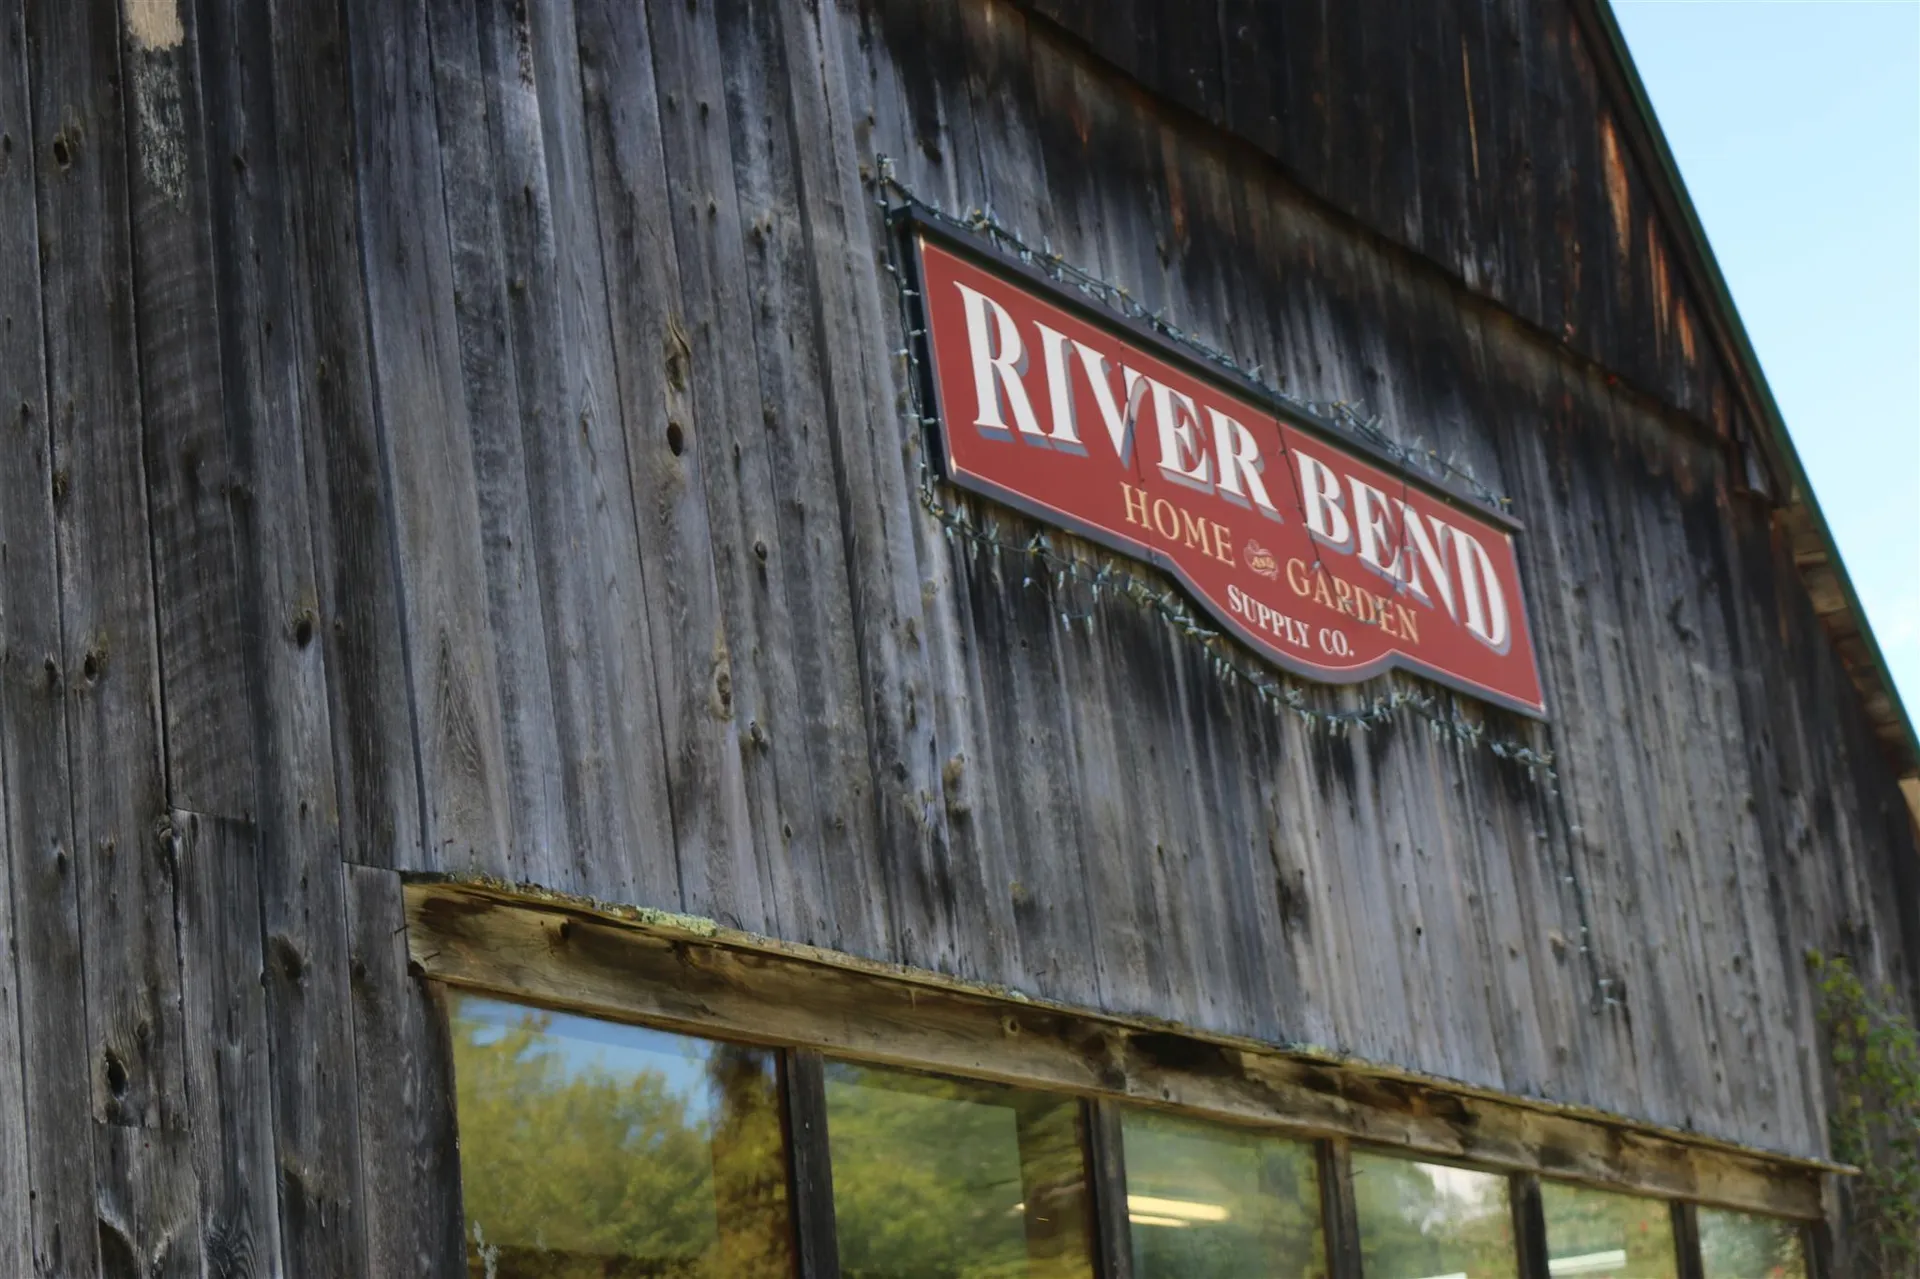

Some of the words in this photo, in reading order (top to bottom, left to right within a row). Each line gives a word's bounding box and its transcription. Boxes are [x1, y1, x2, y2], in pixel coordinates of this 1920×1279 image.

[953, 280, 1282, 518] RIVER
[1292, 447, 1510, 652] BEND
[1120, 481, 1236, 568] HOME
[1286, 557, 1420, 645] GARDEN
[1227, 584, 1310, 649] SUPPLY
[1319, 627, 1354, 657] CO.
